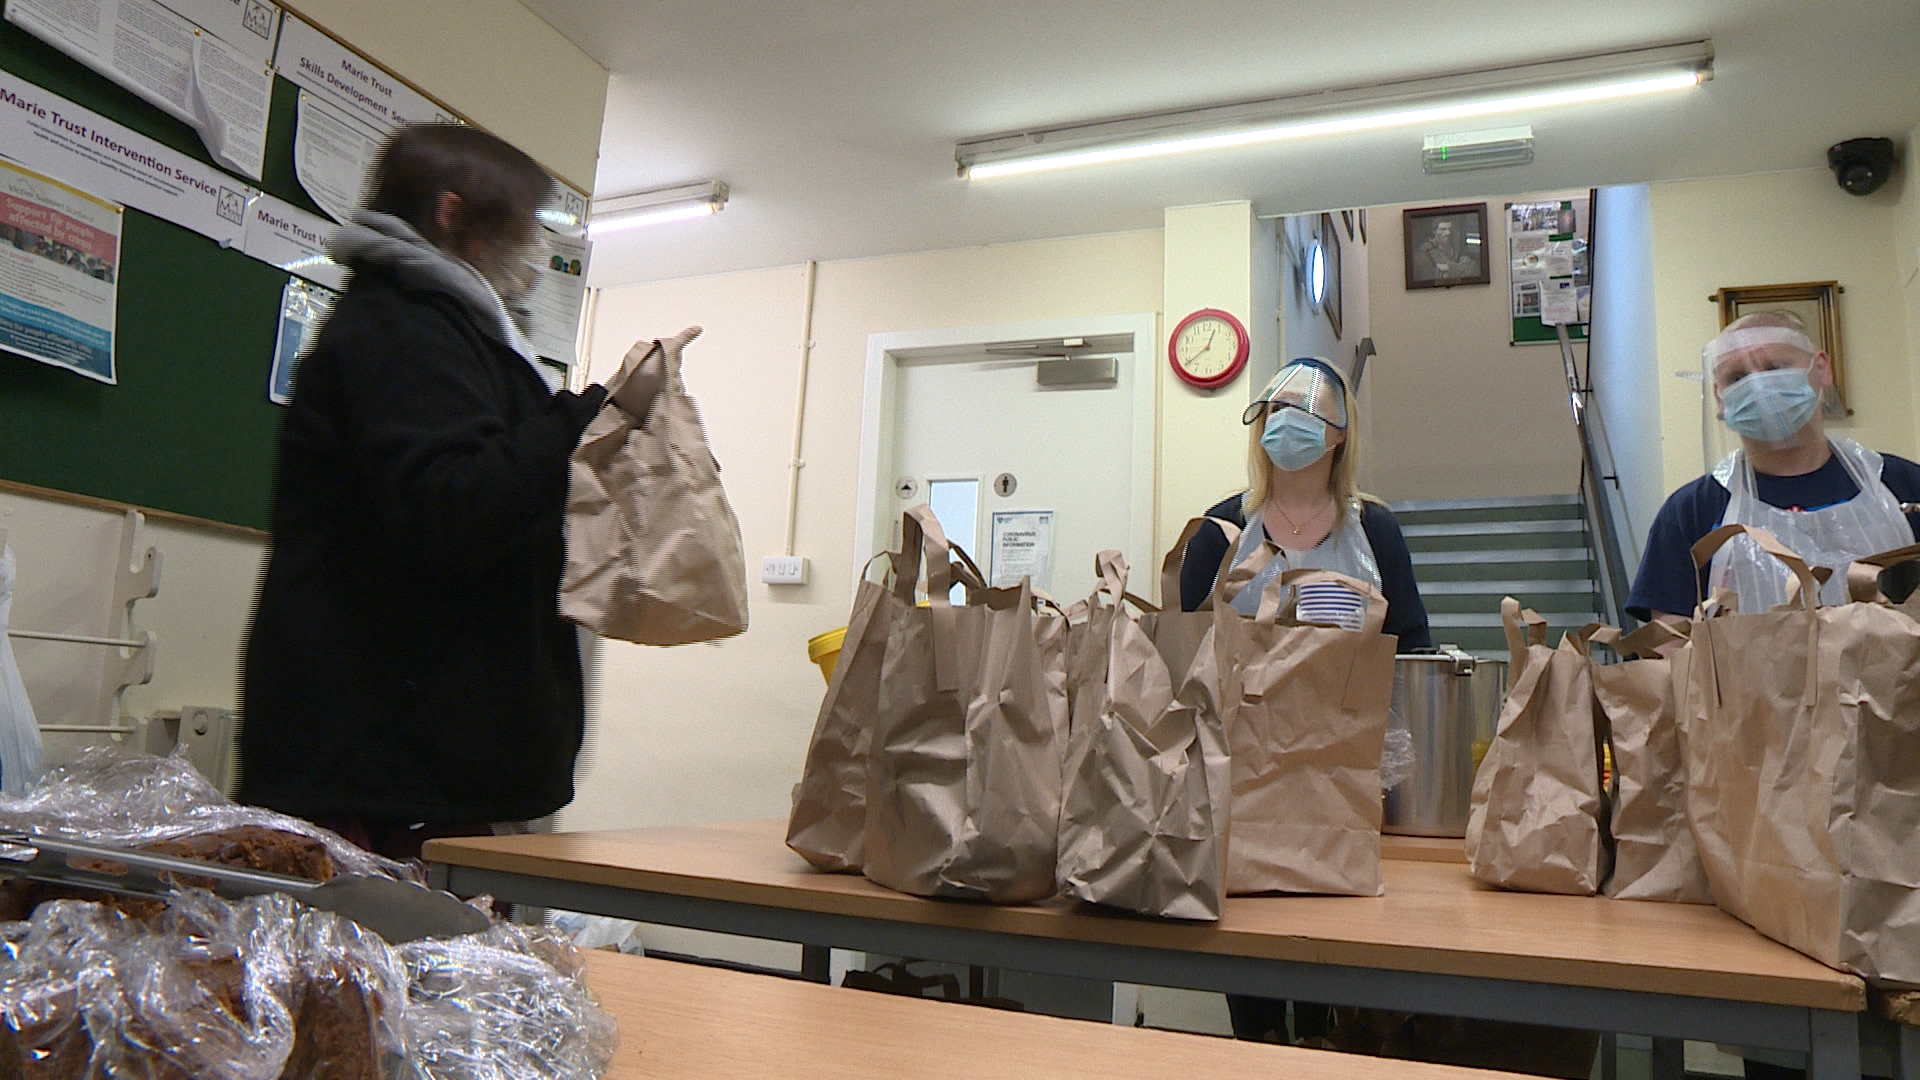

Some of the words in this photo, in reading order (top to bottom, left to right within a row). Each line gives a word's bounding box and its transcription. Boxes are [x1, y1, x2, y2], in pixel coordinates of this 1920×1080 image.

[299, 56, 326, 79] Skills
[326, 72, 388, 116] Development
[342, 59, 369, 83] Marie
[371, 77, 393, 98] Trust
[0, 87, 47, 119] Marie
[50, 111, 88, 139] Trust
[90, 130, 172, 178] Intervention
[174, 169, 217, 197] Service
[6, 198, 47, 219] Support
[8, 214, 52, 233] affected
[257, 209, 289, 232] Marie
[292, 224, 317, 244] Trust
